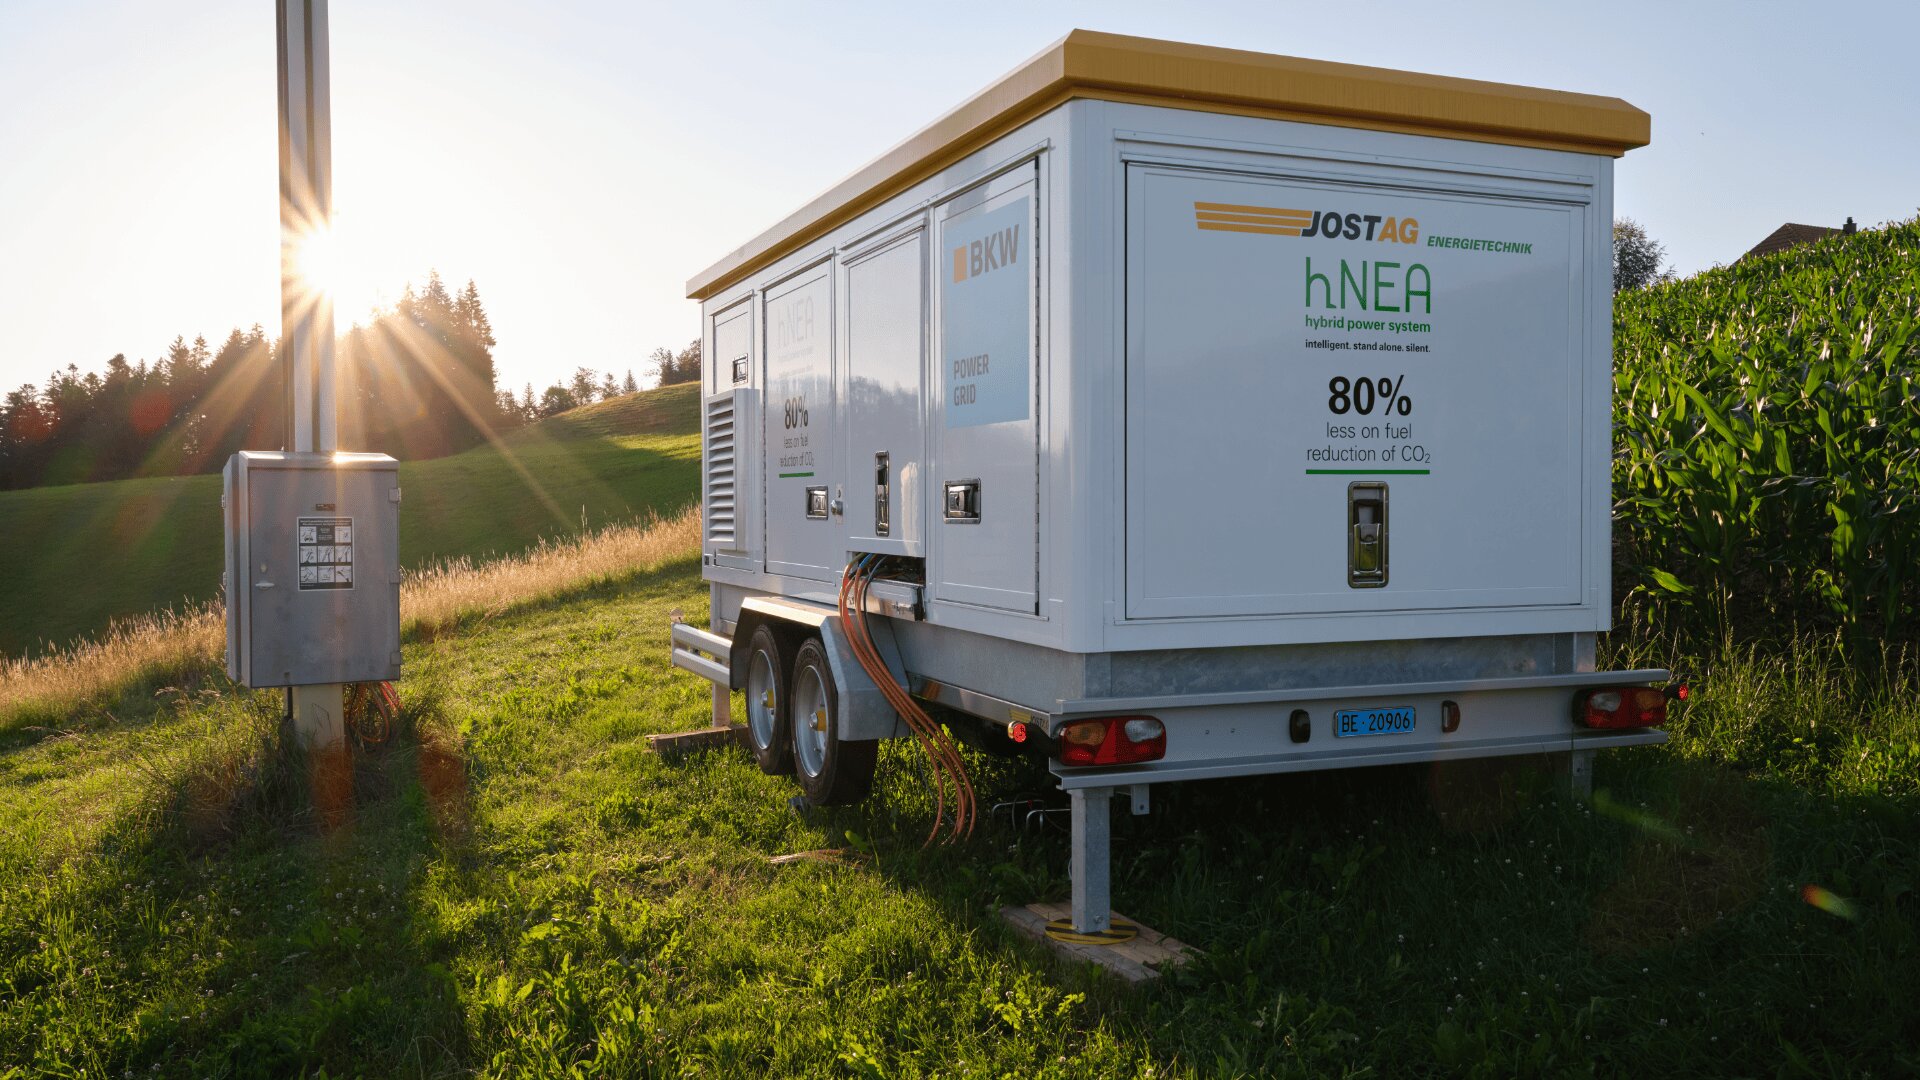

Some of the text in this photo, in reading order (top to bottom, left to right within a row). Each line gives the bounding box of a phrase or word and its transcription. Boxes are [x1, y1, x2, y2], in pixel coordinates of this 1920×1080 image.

[970, 224, 1019, 278] BKW
[1427, 235, 1533, 255] ENERGIETECHNIK
[1305, 256, 1431, 314] hNEA
[1305, 314, 1431, 334] hybrid power system
[1305, 339, 1431, 354] intelligent. stand alone. silent.
[953, 353, 990, 380] POWER
[953, 383, 977, 407] GRID
[1328, 375, 1412, 416] 80%
[784, 392, 808, 429] 80%
[1326, 421, 1412, 439] less on fuel
[1306, 446, 1377, 462] reduction
[1382, 446, 1396, 462] of
[1342, 711, 1410, 732] BE 20906
